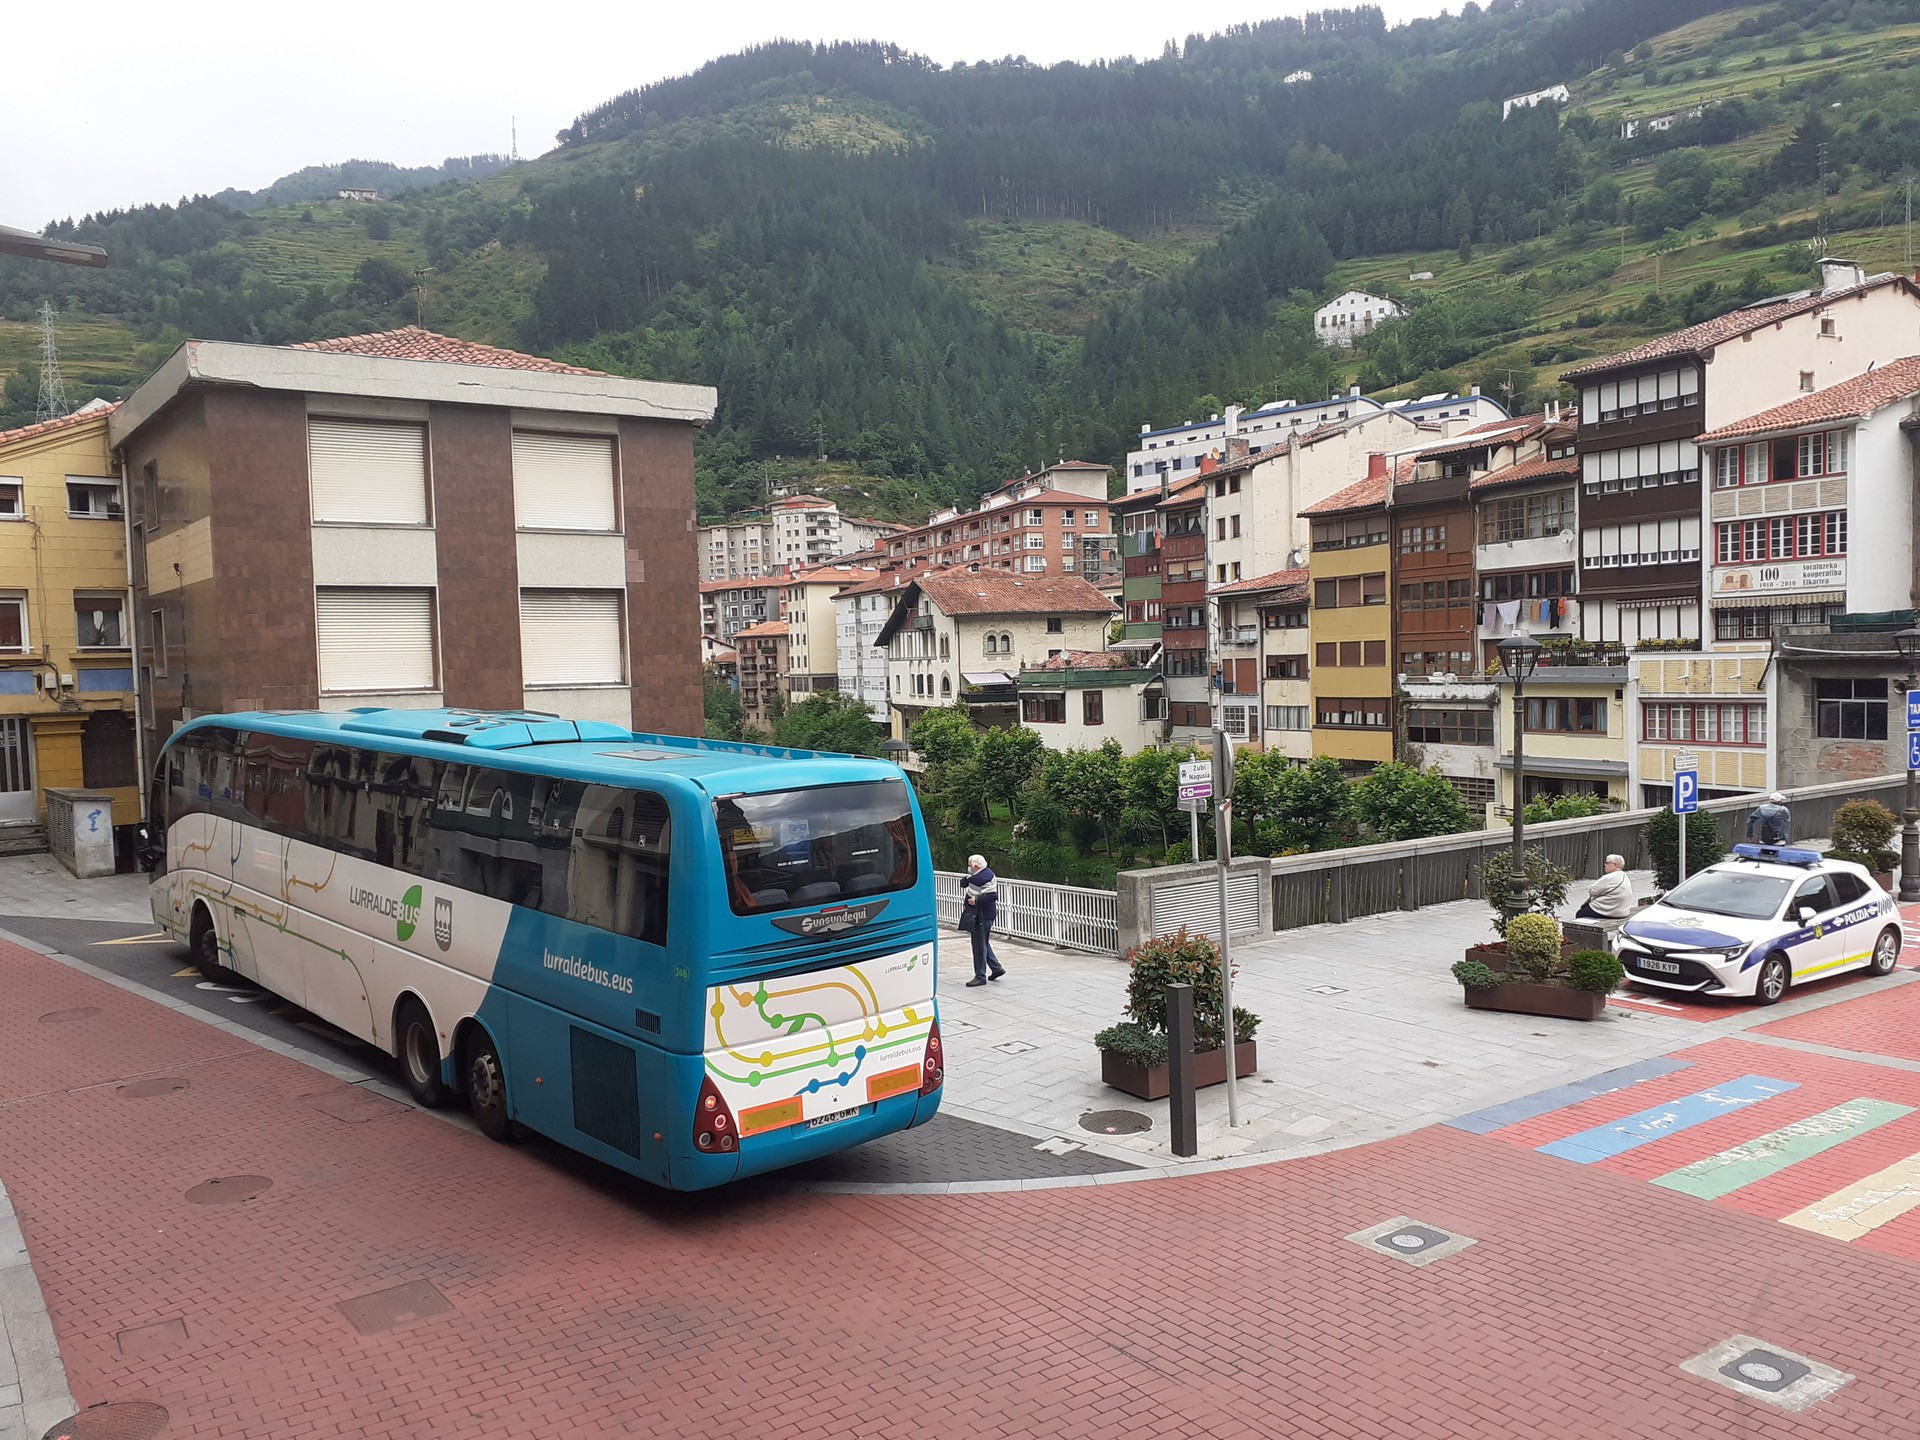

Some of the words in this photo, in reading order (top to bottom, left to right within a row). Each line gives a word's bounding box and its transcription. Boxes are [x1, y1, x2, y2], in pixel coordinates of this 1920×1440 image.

[1760, 568, 1780, 582] 100
[1802, 569, 1842, 578] Kooperatiba
[1188, 772, 1210, 780] Nagusia
[1679, 776, 1694, 809] P
[801, 907, 867, 932] Sunsundegui
[1844, 908, 1870, 926] POLIZIA
[543, 948, 633, 995] lurraldebus.eus
[1642, 959, 1660, 970] 1926
[1662, 963, 1677, 972] KYP
[879, 1045, 922, 1062] lurraldebus.eus
